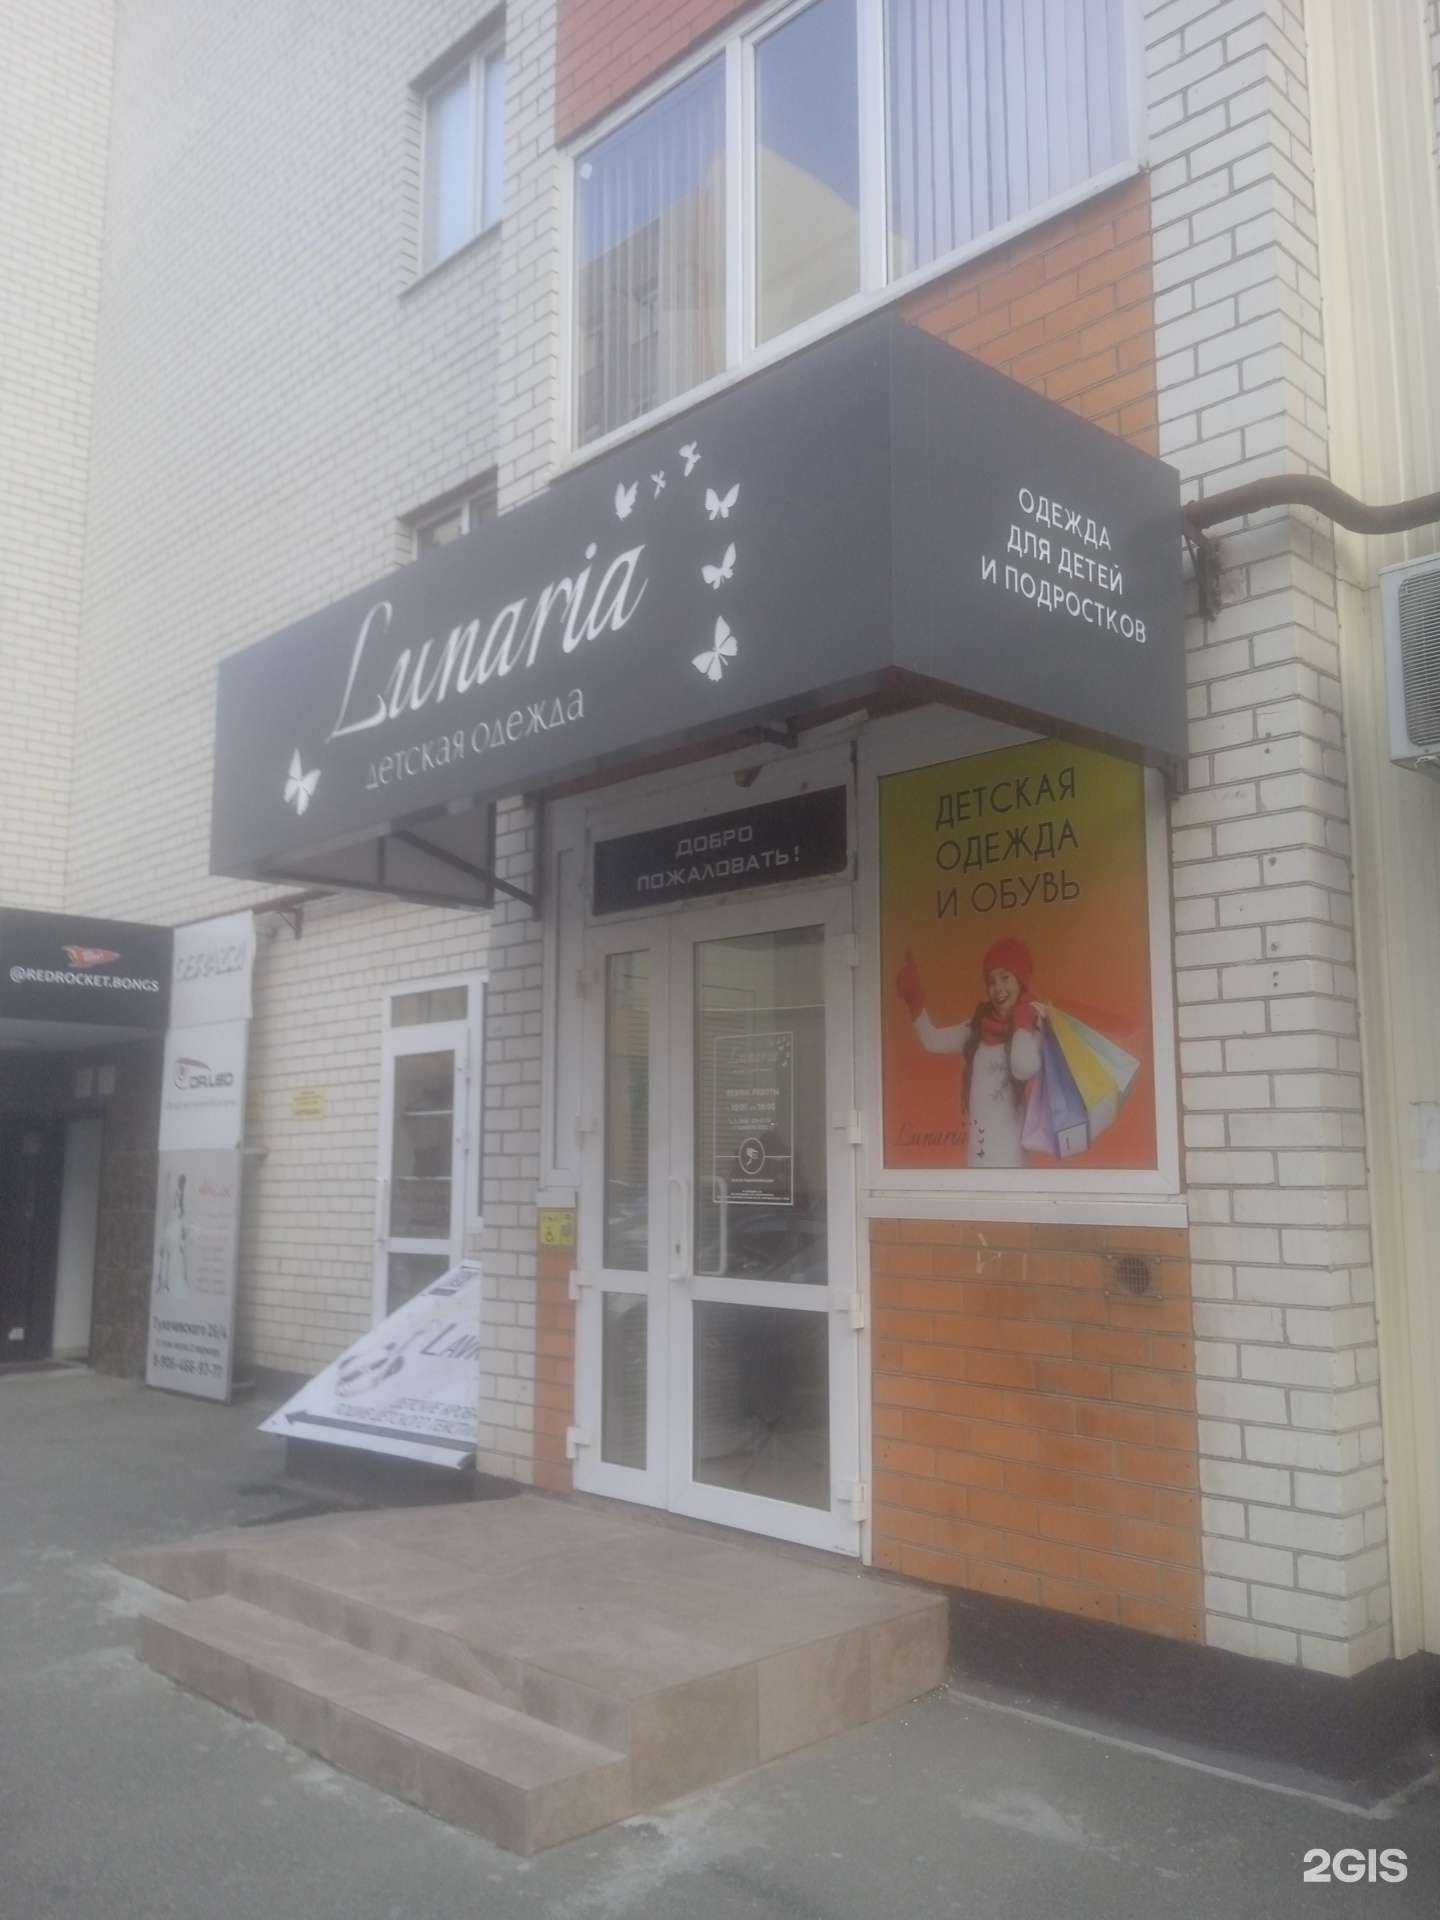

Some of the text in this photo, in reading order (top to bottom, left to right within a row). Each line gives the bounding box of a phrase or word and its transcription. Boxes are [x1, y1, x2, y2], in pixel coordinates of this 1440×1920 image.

[1018, 487, 1112, 551] ОДЕЖДА
[1007, 524, 1123, 596] ДЛЯ ДЕТЕЙ
[981, 555, 1146, 643] И ПОДРОСТКОВ
[325, 542, 649, 744] Lunaria
[471, 688, 585, 755] одежда
[936, 766, 1076, 832] ДЕТСКАЯ
[675, 825, 754, 860] ДОБРО
[936, 817, 1080, 874] ОДЕЖДА
[936, 870, 1081, 919] И ОБУВЬ
[9, 965, 160, 993] @REDROCKET.BONGS
